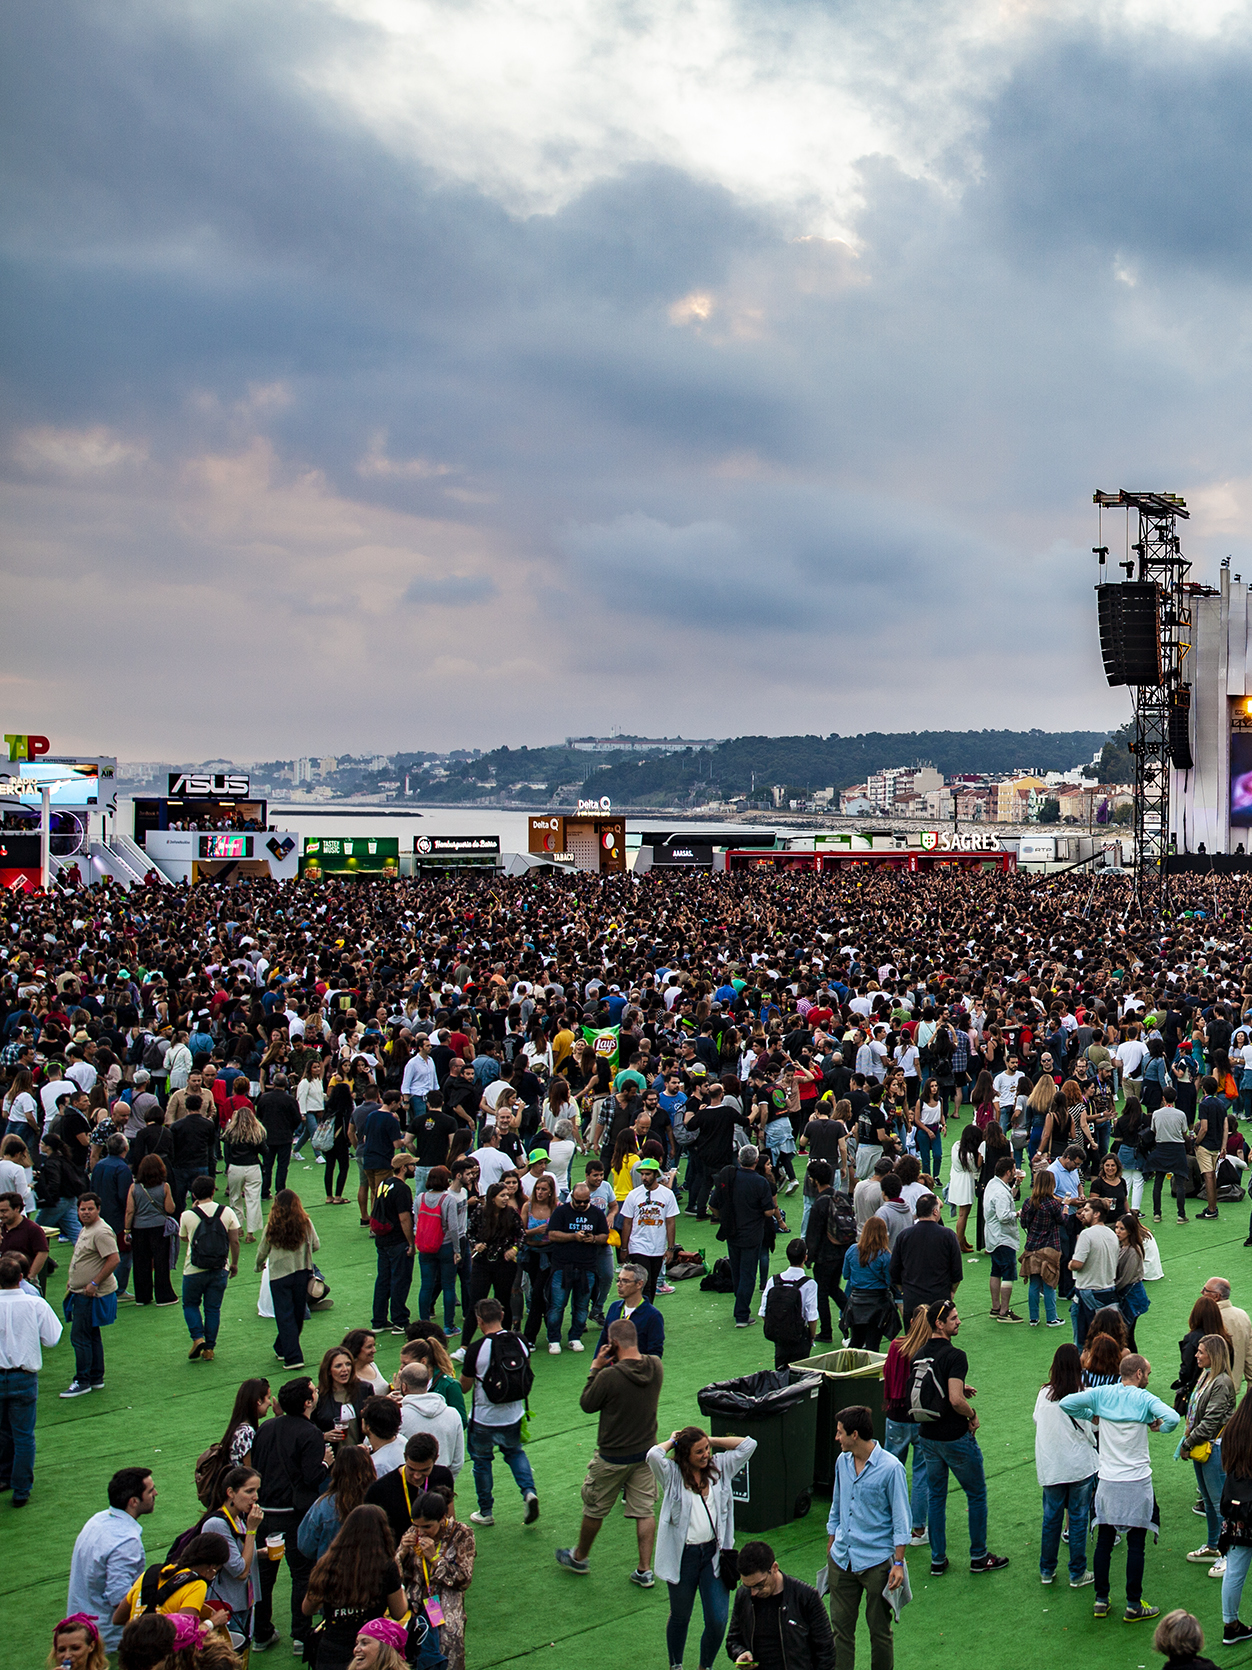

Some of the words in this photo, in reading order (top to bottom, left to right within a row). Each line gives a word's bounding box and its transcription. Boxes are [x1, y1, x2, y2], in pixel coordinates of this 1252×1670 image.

[4, 734, 50, 761] TAP
[171, 774, 249, 794] ASUS
[578, 798, 599, 810] Delta
[600, 796, 611, 812] Q
[533, 820, 549, 829] Delta
[550, 818, 559, 831] Q
[941, 832, 1001, 851] SAGRES
[554, 853, 575, 862] TABACO
[595, 1038, 616, 1053] Lay's
